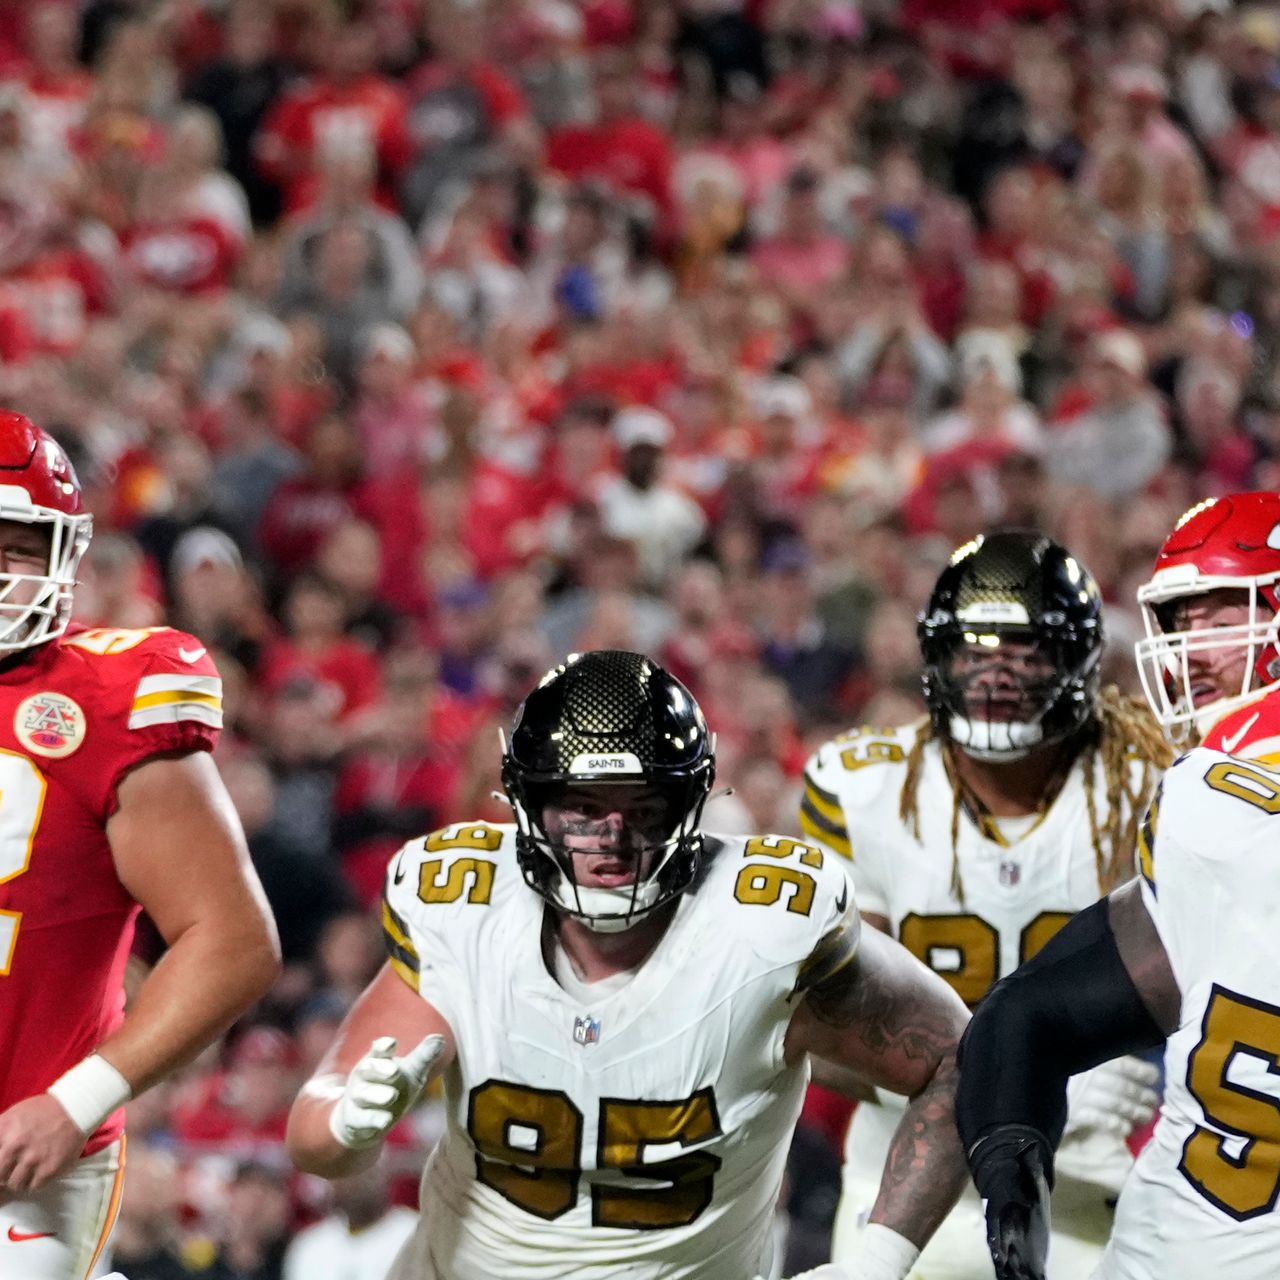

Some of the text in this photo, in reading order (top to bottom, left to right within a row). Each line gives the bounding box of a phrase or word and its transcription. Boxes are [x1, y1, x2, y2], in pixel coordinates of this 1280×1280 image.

[588, 758, 625, 769] SAINTS
[417, 823, 503, 906] 95
[733, 834, 824, 917] 95
[468, 1078, 724, 1230] 95
